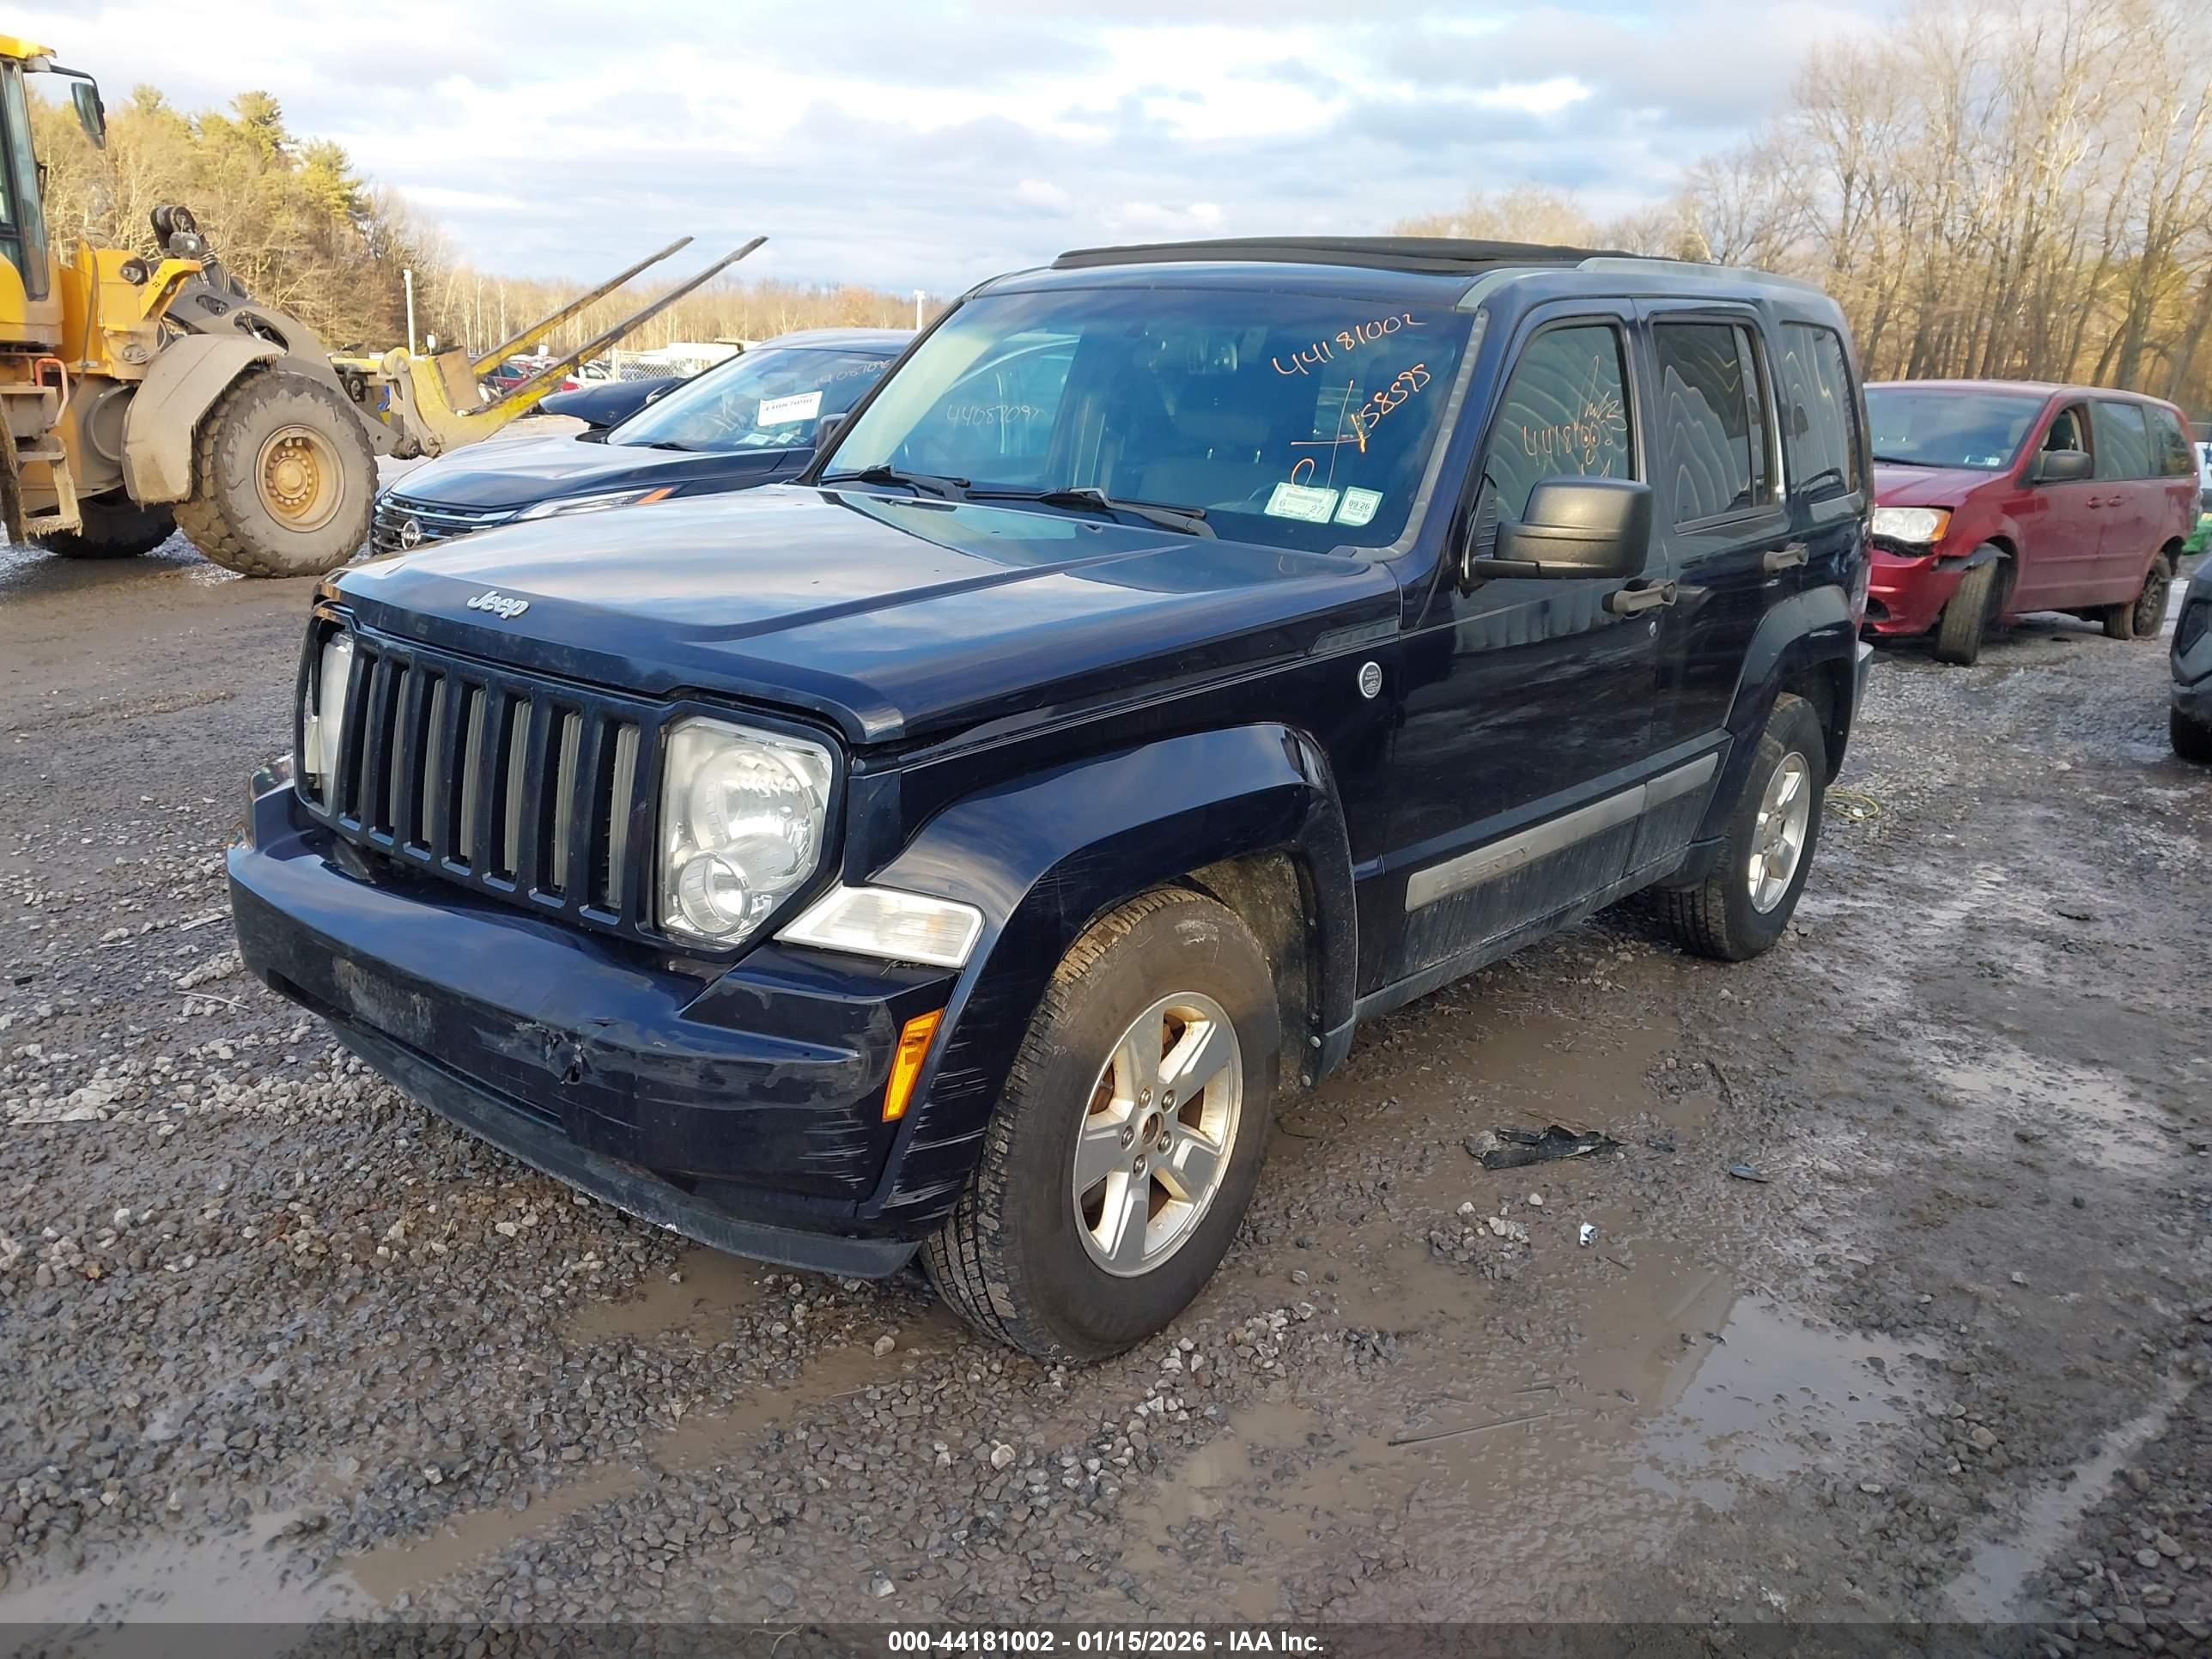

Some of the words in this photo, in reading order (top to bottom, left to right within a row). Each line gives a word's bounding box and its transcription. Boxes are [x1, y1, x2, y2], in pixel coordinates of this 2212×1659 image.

[1271, 312, 1428, 376] 44181002
[1310, 504, 1325, 514] 27
[1348, 499, 1358, 508] 09
[466, 590, 530, 620] Jeep
